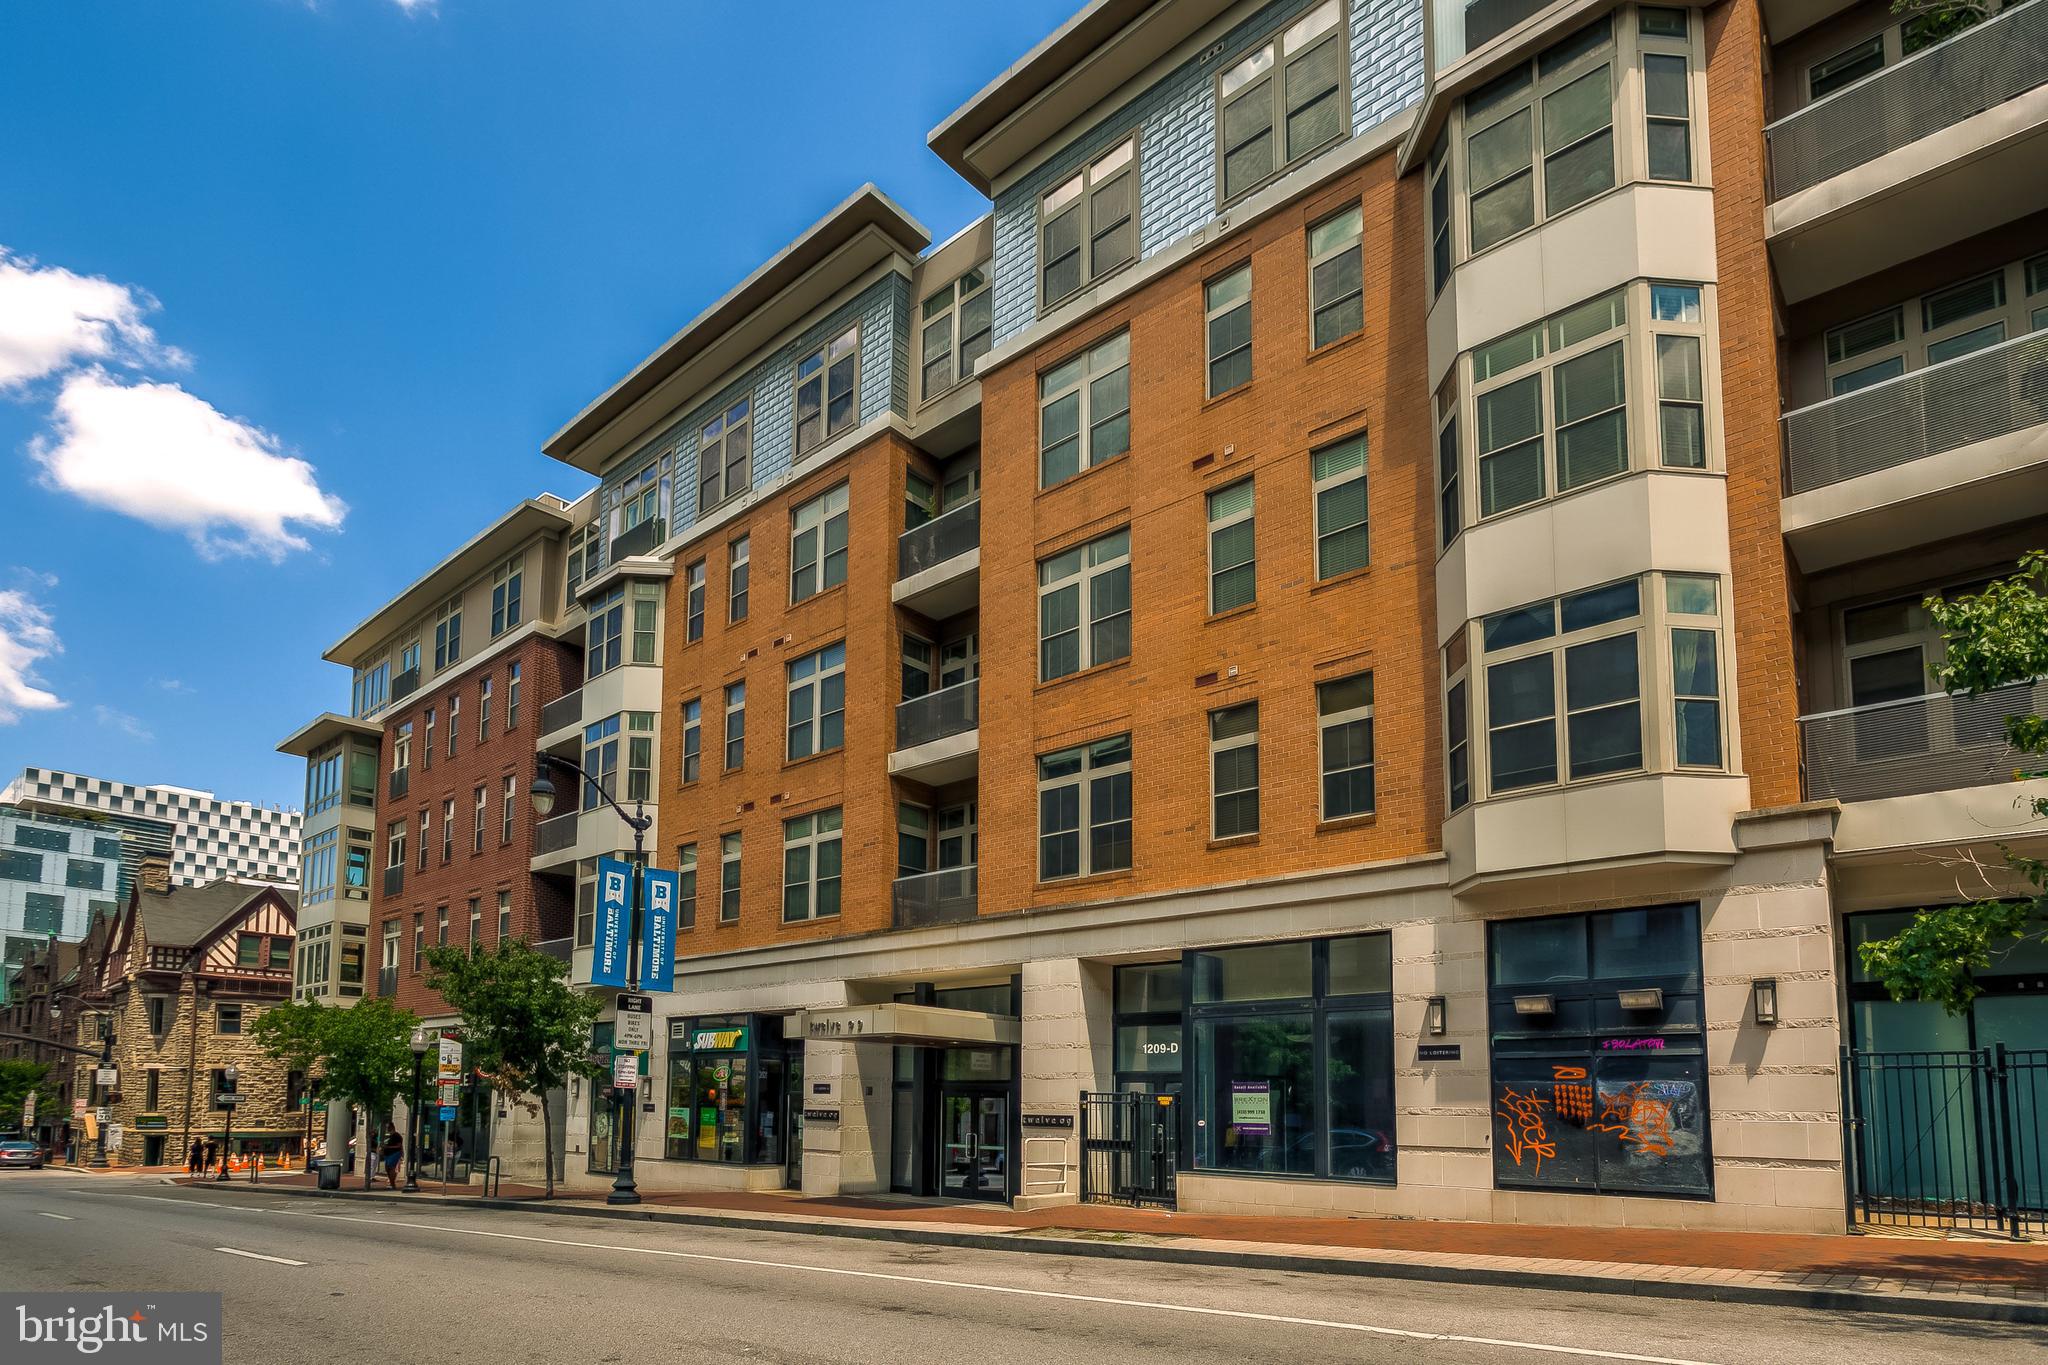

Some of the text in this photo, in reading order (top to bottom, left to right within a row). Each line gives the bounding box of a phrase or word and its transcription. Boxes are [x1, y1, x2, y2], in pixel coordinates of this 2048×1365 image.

[609, 876, 622, 892] B
[655, 885, 668, 899] B
[603, 907, 614, 974] BALTIMORE
[651, 915, 662, 979] BALTIMORE
[693, 1030, 743, 1050] SUBWAY
[1142, 1043, 1179, 1054] 1209-D
[1023, 1115, 1057, 1124] twelve
